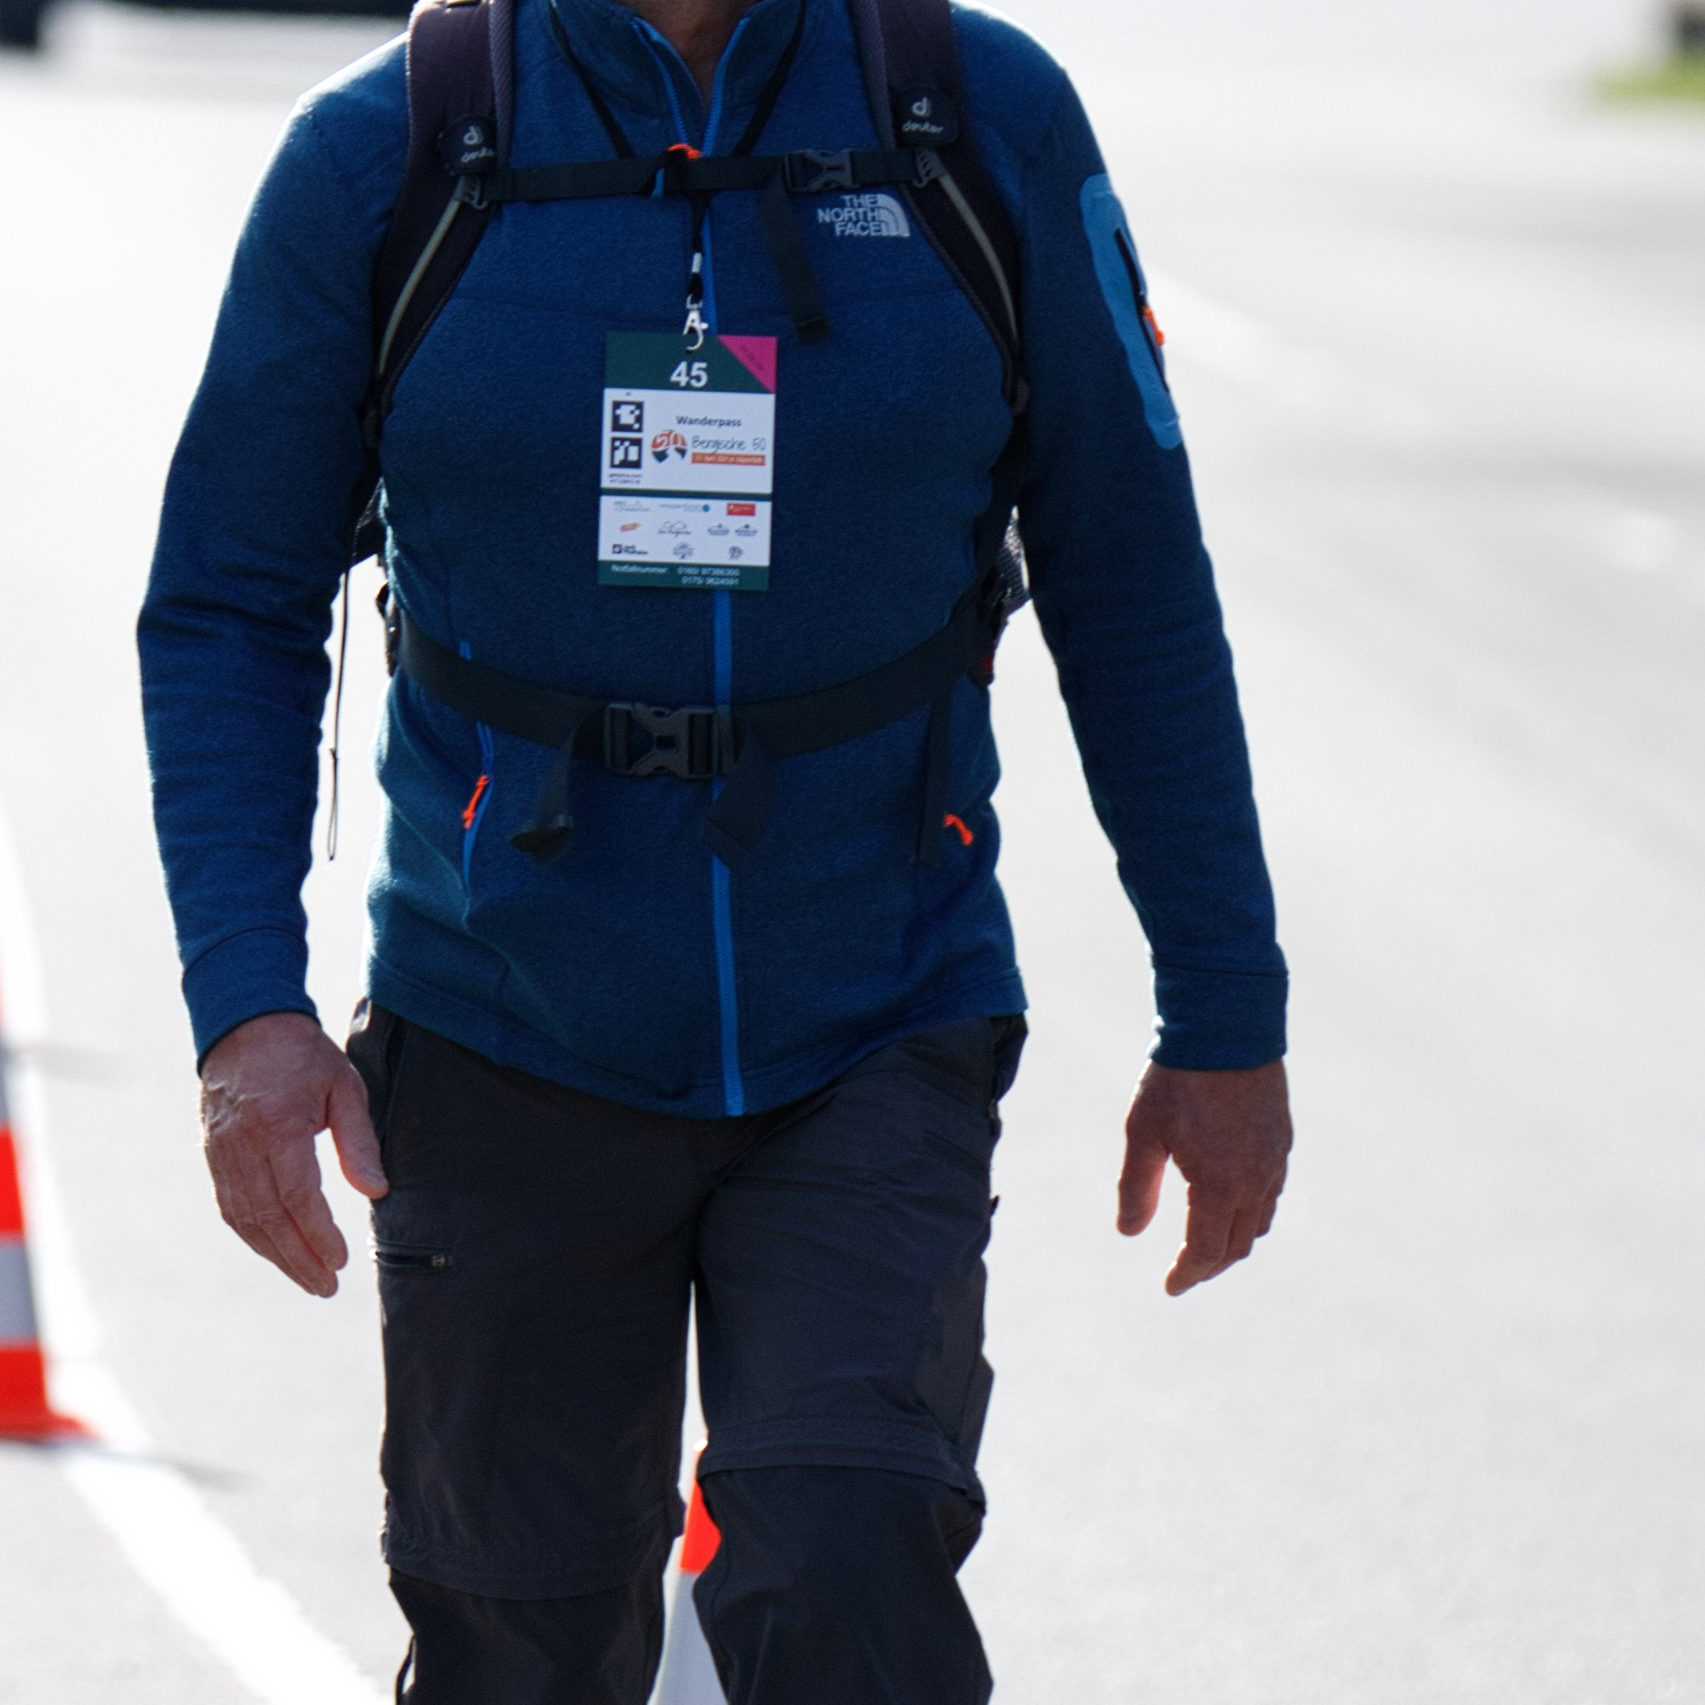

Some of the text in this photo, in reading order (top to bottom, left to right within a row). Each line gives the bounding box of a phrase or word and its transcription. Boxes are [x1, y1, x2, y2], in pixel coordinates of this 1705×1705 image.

[840, 193, 878, 207] THE
[816, 207, 880, 223] NORTH
[834, 221, 882, 237] FACE
[670, 361, 708, 388] 45
[676, 415, 743, 429] Wanderpass
[752, 436, 768, 452] 50
